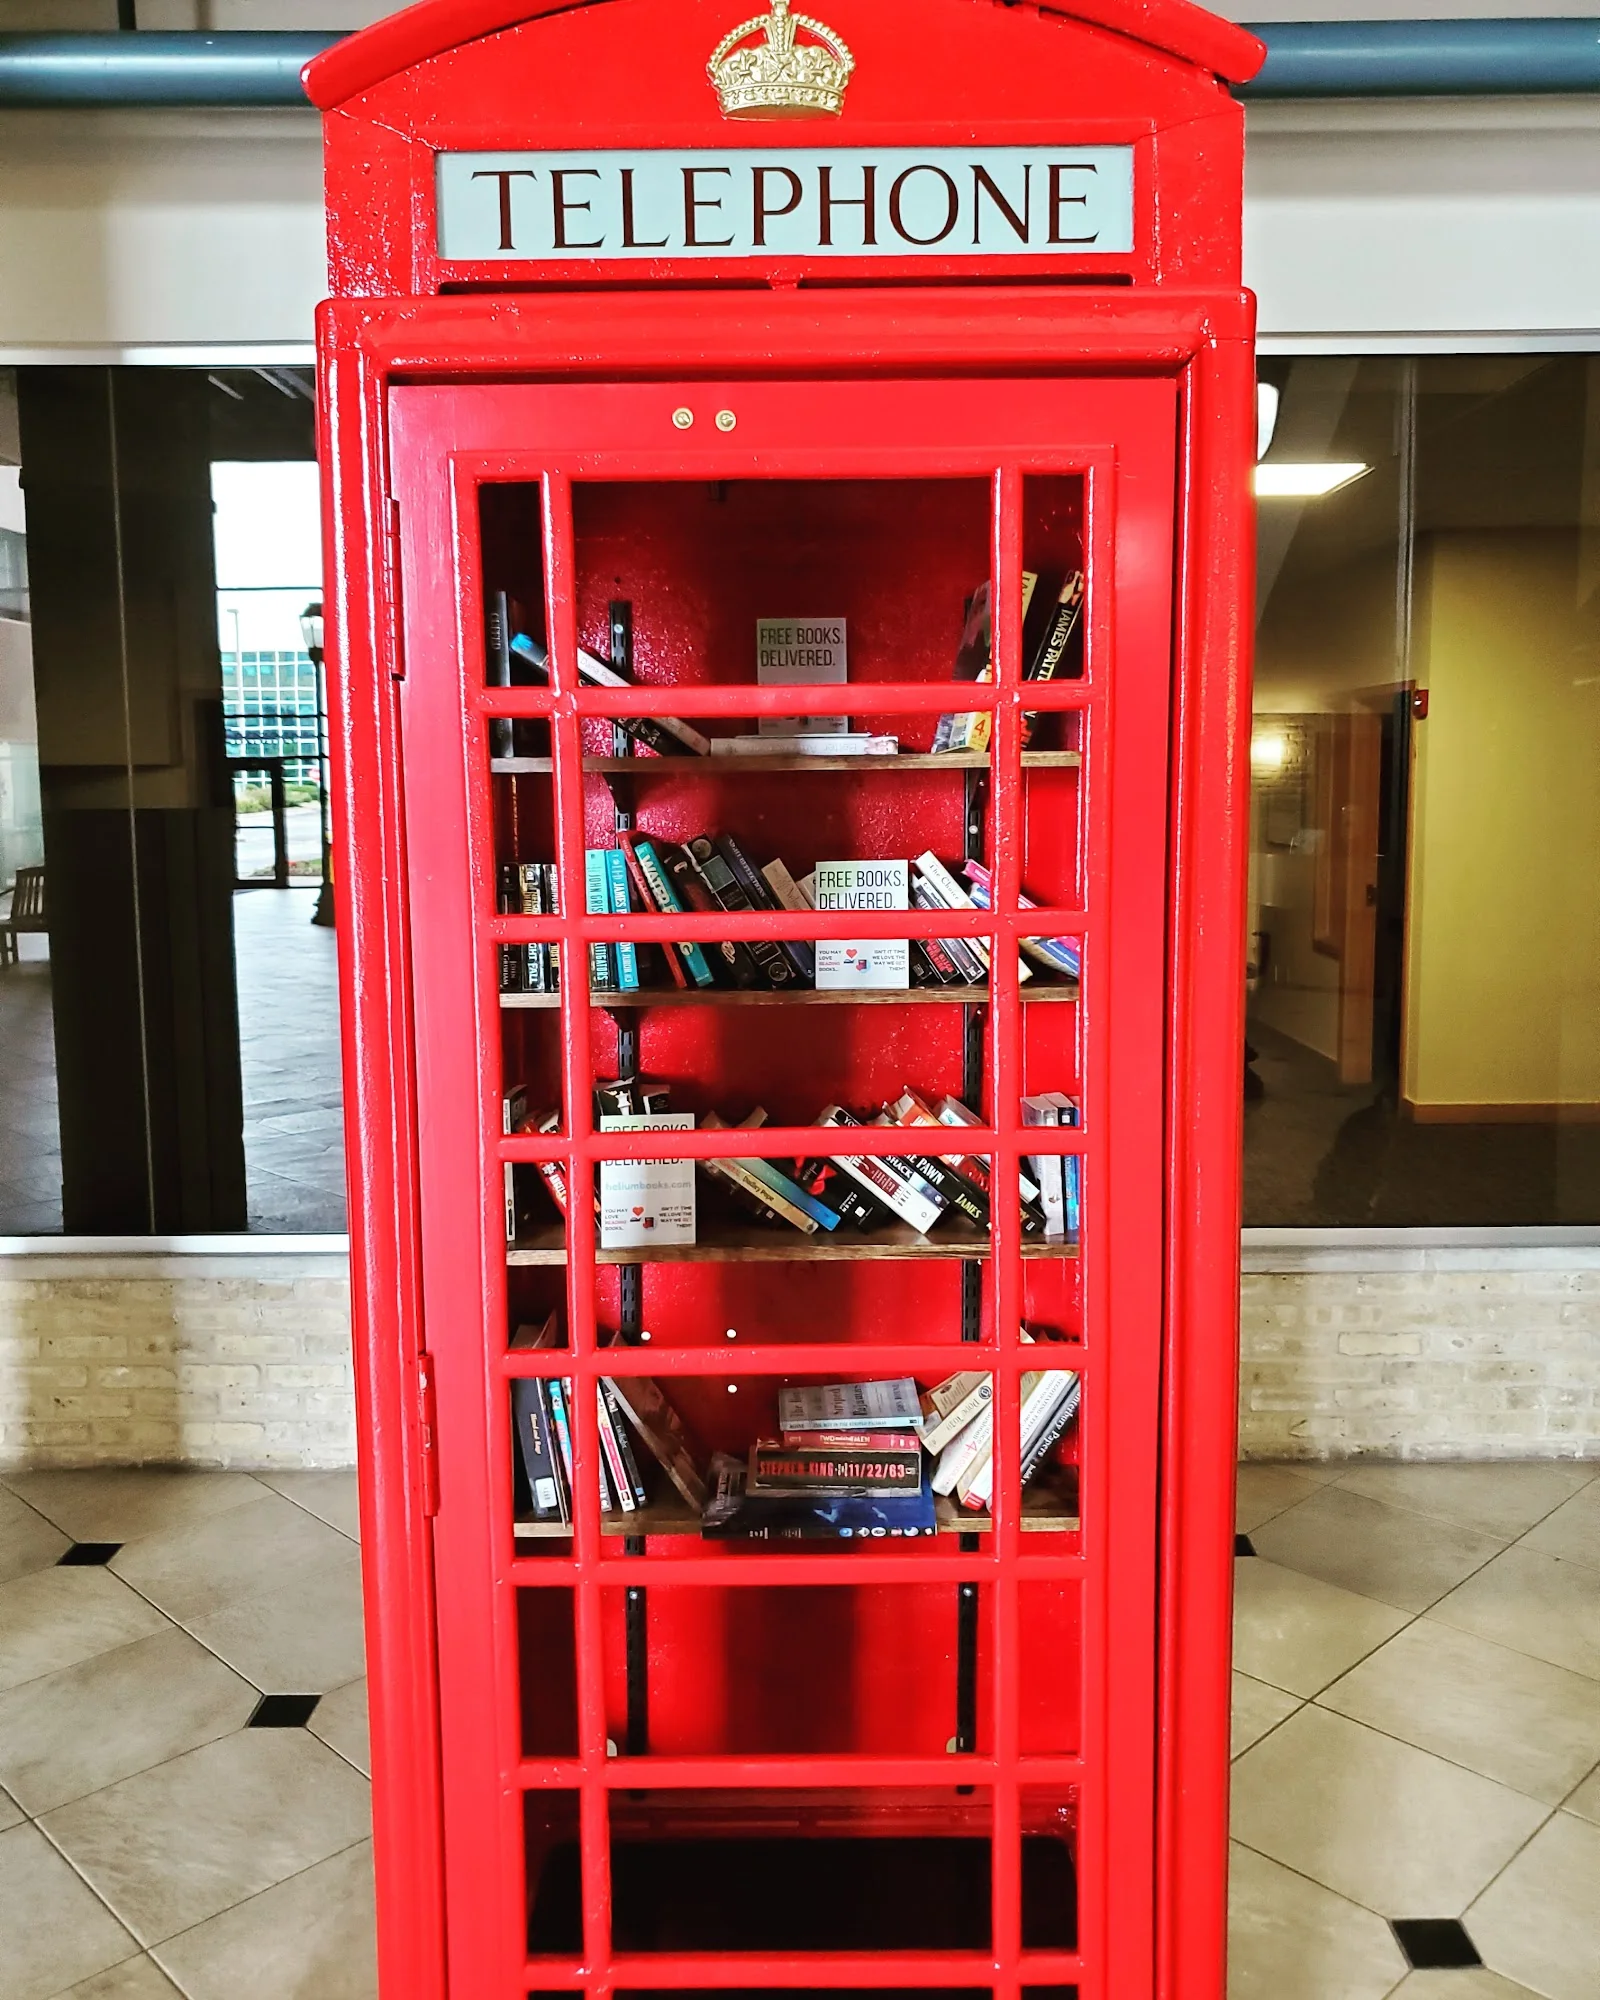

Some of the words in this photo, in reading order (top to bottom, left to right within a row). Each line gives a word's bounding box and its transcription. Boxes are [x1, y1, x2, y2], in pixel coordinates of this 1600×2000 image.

[471, 163, 1100, 251] TELEPHONE
[760, 628, 793, 645] FREE
[797, 627, 844, 645] BOOKS.
[1050, 608, 1073, 647] JAMES
[760, 649, 836, 667] DELIVERED.
[588, 874, 602, 893] JOHN
[819, 870, 853, 888] FREE
[856, 870, 905, 887] BOOKS.
[941, 876, 960, 900] Choice
[591, 894, 604, 913] GRIS
[612, 881, 627, 907] JAMES
[819, 892, 897, 909] DELIVERED.
[528, 942, 538, 962] GHT
[886, 1155, 914, 1179] SHACK
[605, 1180, 692, 1191] heliumbooks.com
[916, 1158, 946, 1185] PAWN
[954, 1193, 983, 1219] JAMES
[1055, 1391, 1081, 1431] anterbury
[1037, 1430, 1061, 1457] Papers
[759, 1460, 805, 1475] STEPHEN
[808, 1461, 834, 1477] KING
[848, 1463, 905, 1478] 11/22/63
